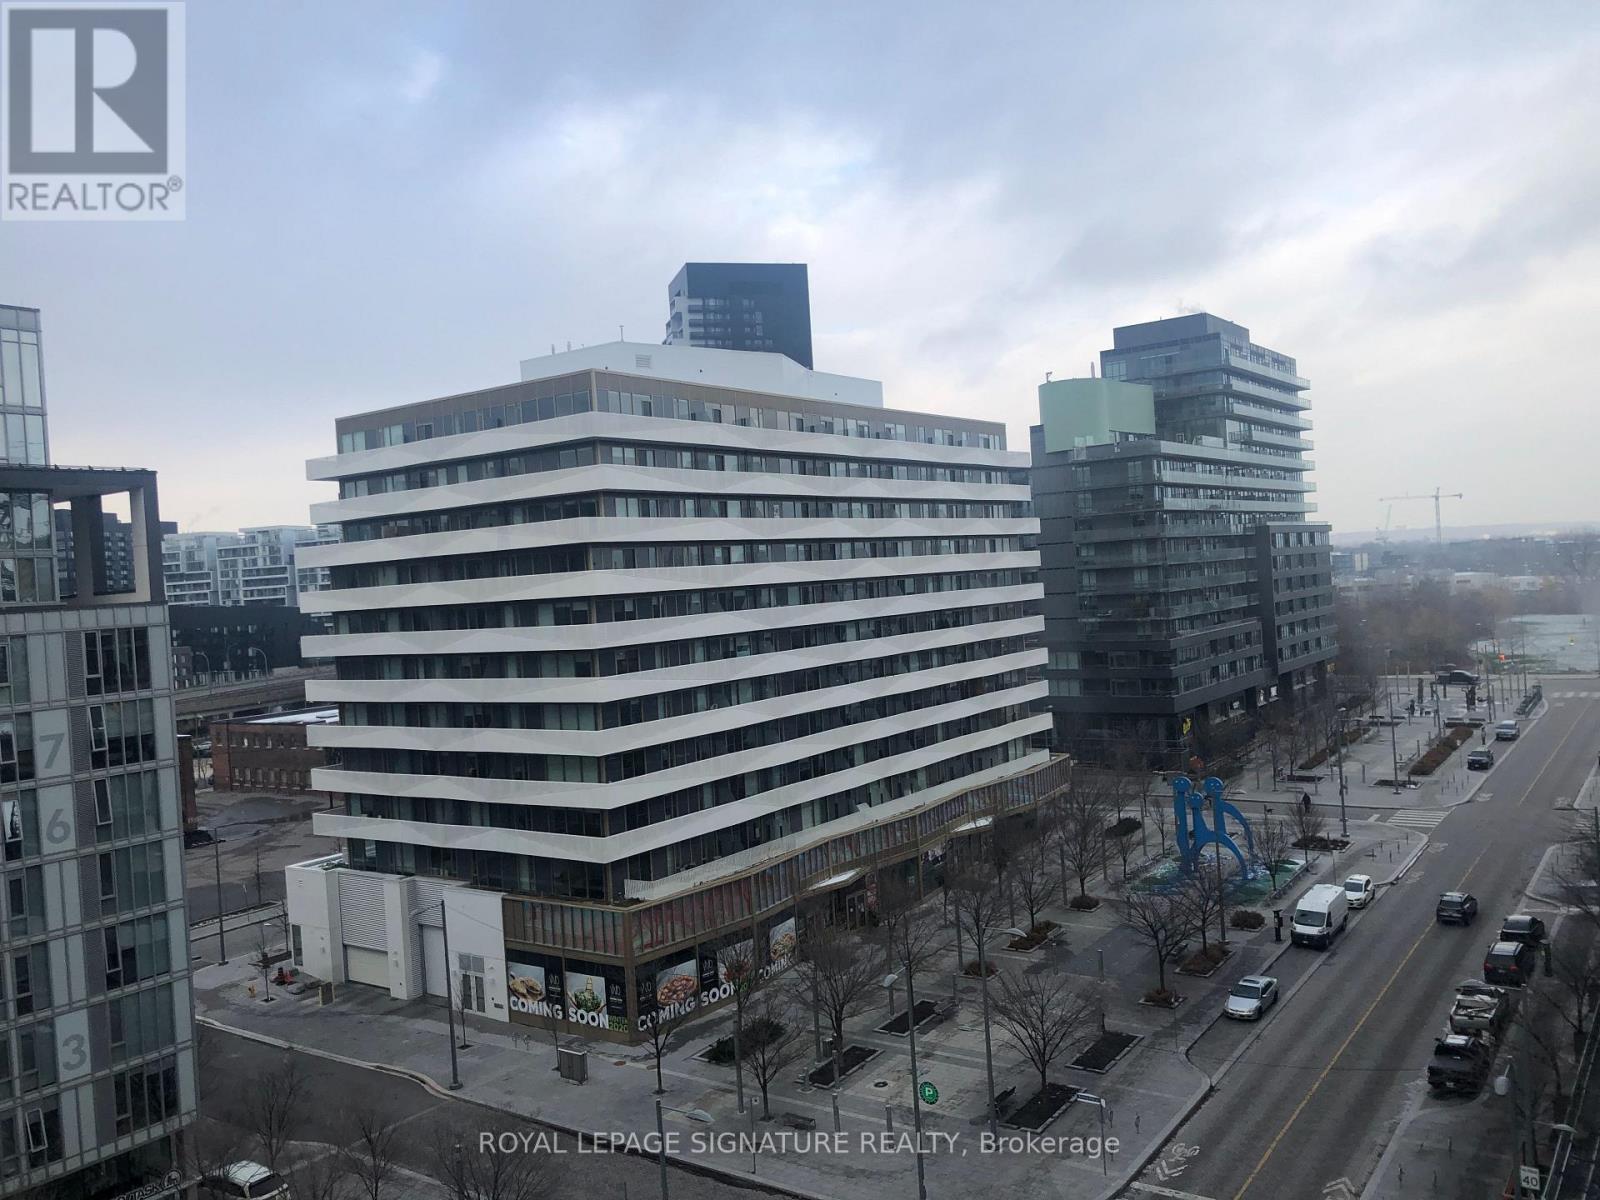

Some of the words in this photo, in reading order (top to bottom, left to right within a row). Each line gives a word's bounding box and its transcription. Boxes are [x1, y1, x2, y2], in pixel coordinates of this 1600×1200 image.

[38, 732, 66, 769] 7
[46, 808, 71, 845] 6
[510, 996, 563, 1020] COMING
[569, 1007, 609, 1029] SOON
[637, 997, 696, 1032] COMING
[62, 1033, 87, 1072] 3
[1522, 1176, 1538, 1187] 40
